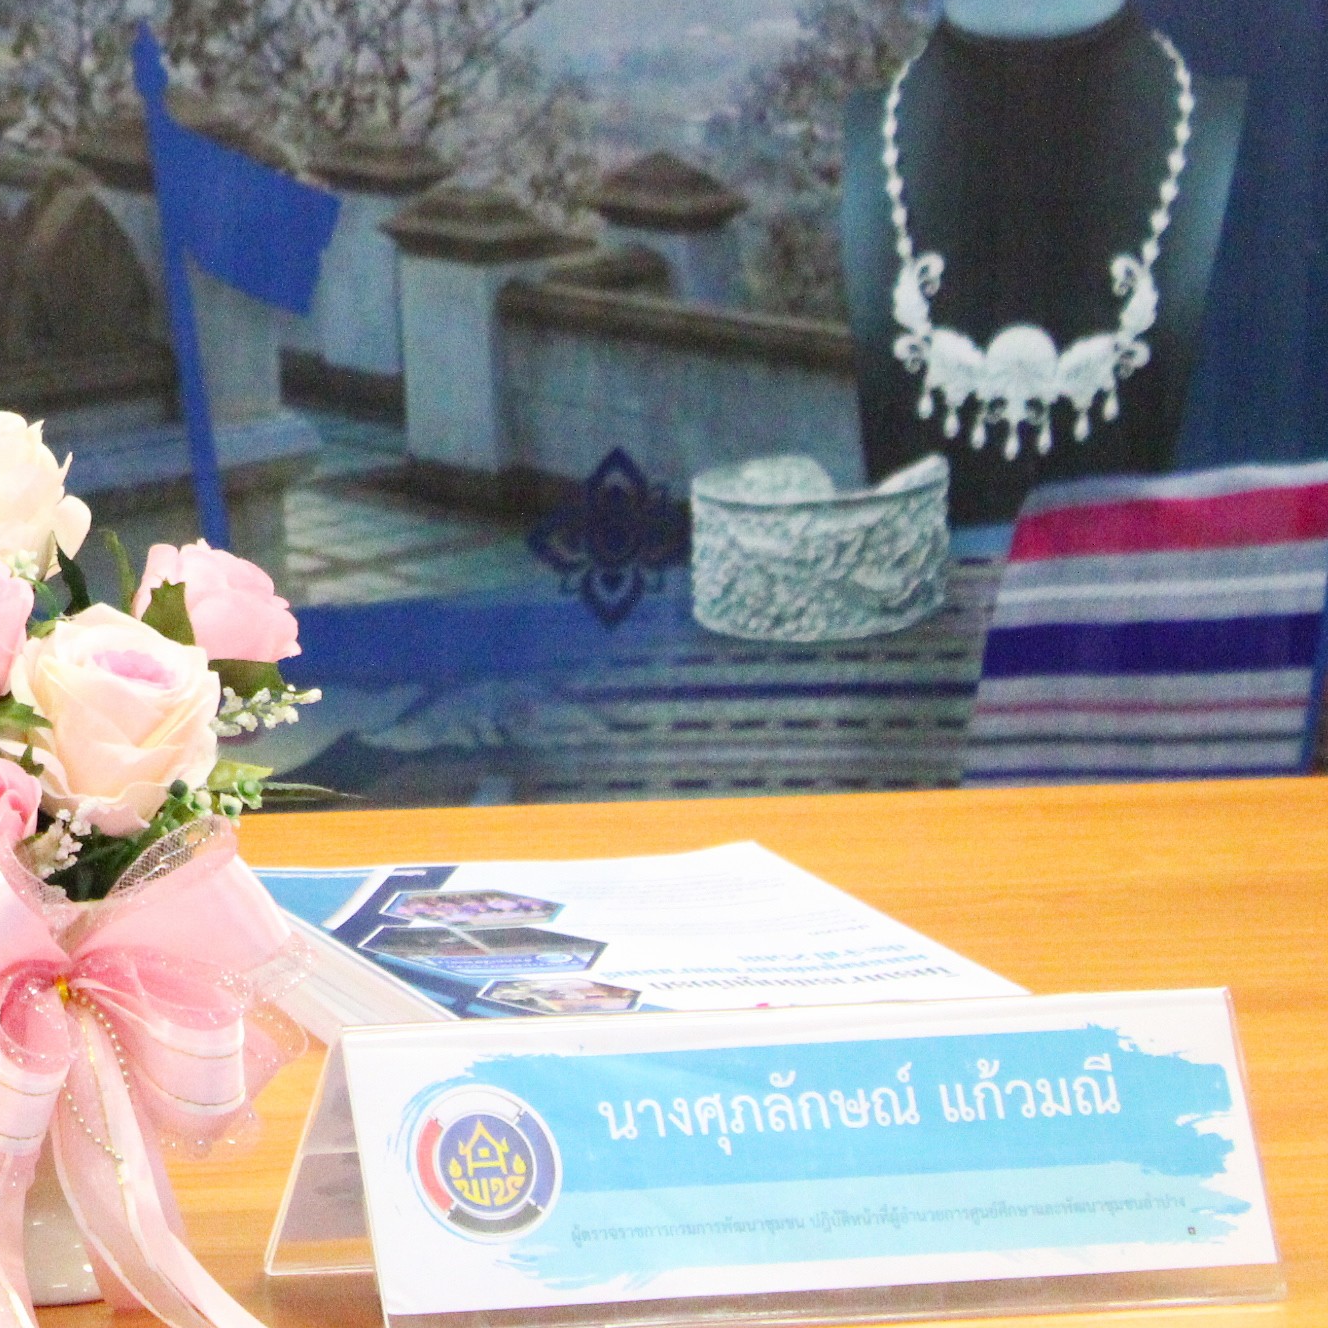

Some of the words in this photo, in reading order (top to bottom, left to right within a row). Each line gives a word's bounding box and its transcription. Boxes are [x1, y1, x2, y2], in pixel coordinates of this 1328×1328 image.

[598, 1061, 921, 1156] นางศุภลักษณ์
[938, 1052, 1122, 1124] แก้วมณี
